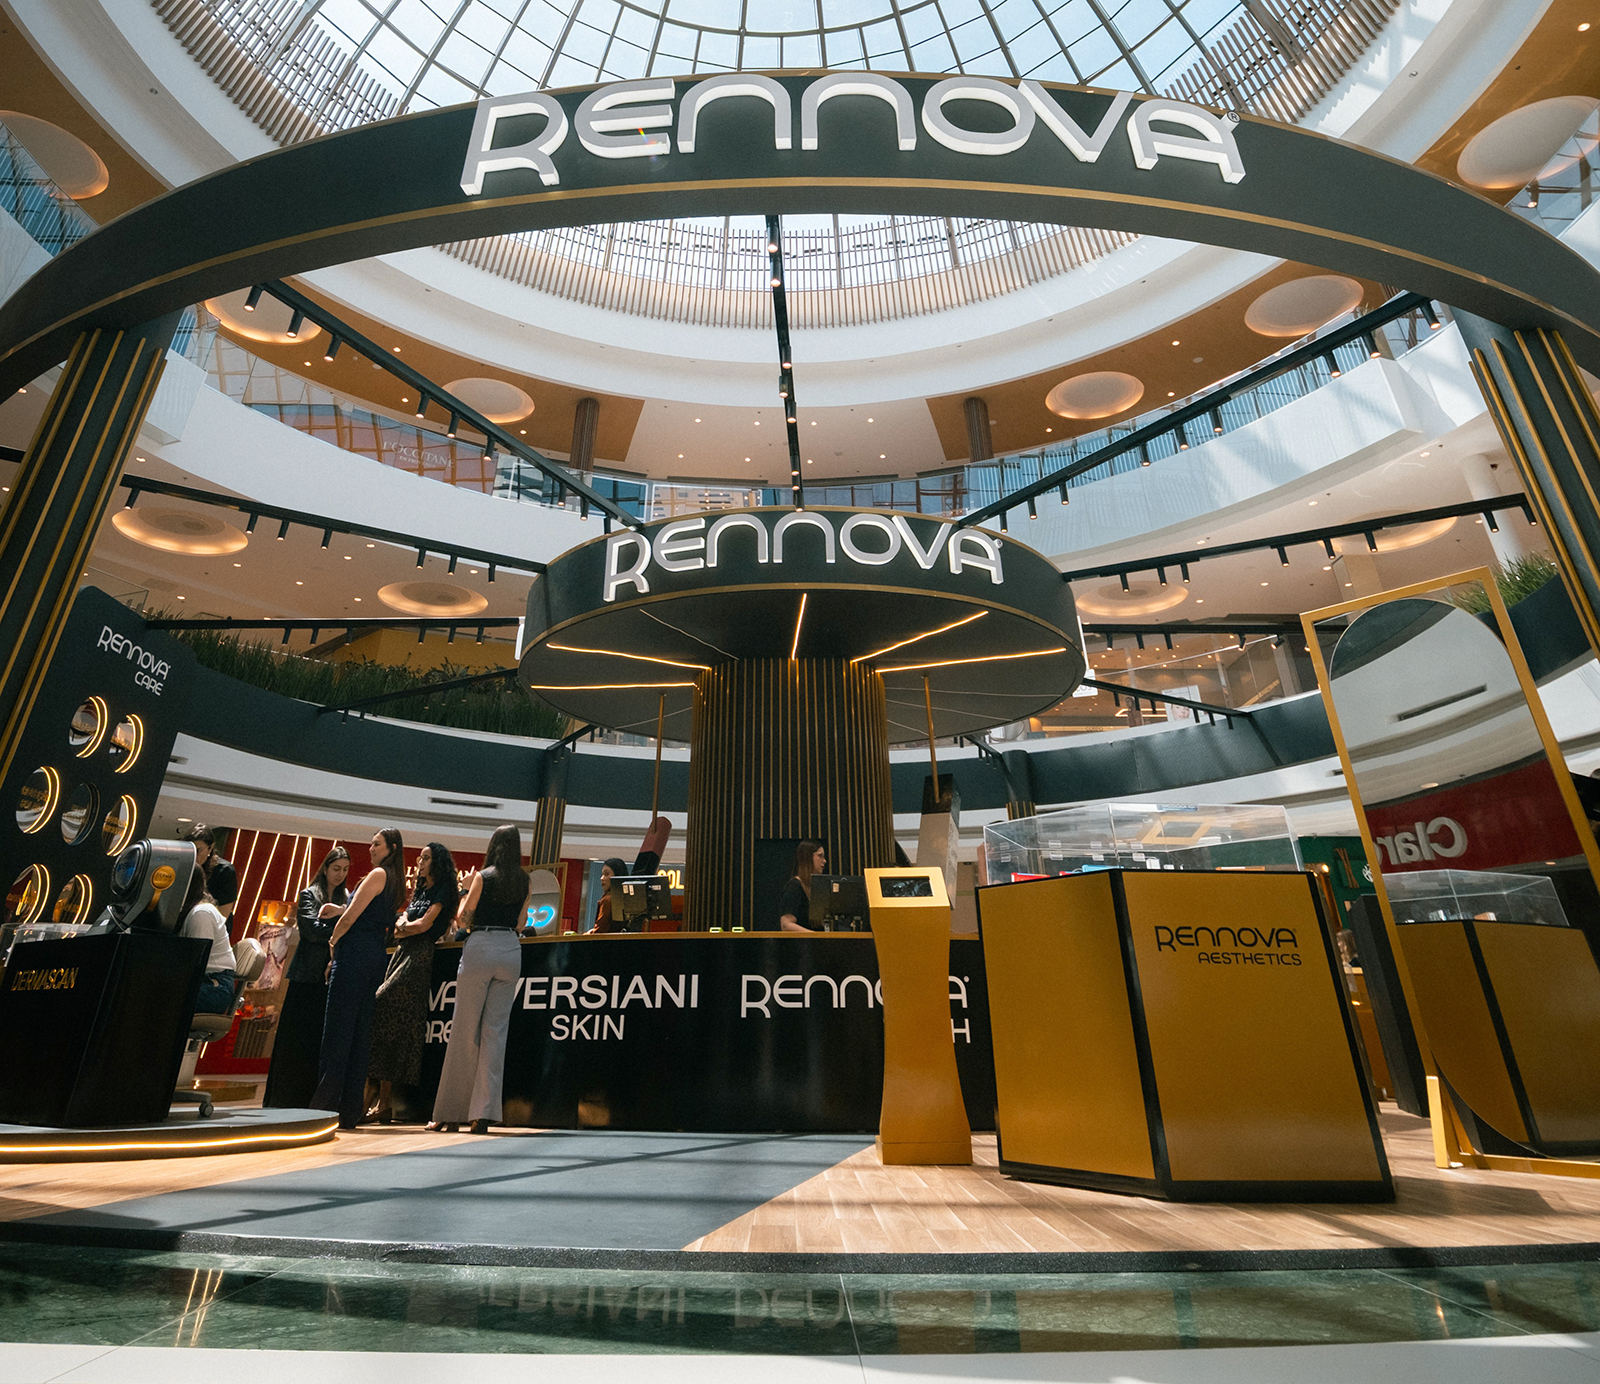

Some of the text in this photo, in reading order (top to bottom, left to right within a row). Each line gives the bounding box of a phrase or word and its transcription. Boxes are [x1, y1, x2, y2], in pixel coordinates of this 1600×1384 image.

[97, 625, 171, 681] RENNOVA
[134, 671, 164, 696] CARE
[1154, 925, 1298, 952] RENNOVA
[1197, 952, 1302, 966] AESTHETICS
[11, 966, 80, 991] DERMASCAN
[740, 974, 969, 1018] RENNA
[550, 1014, 625, 1041] SKIN
